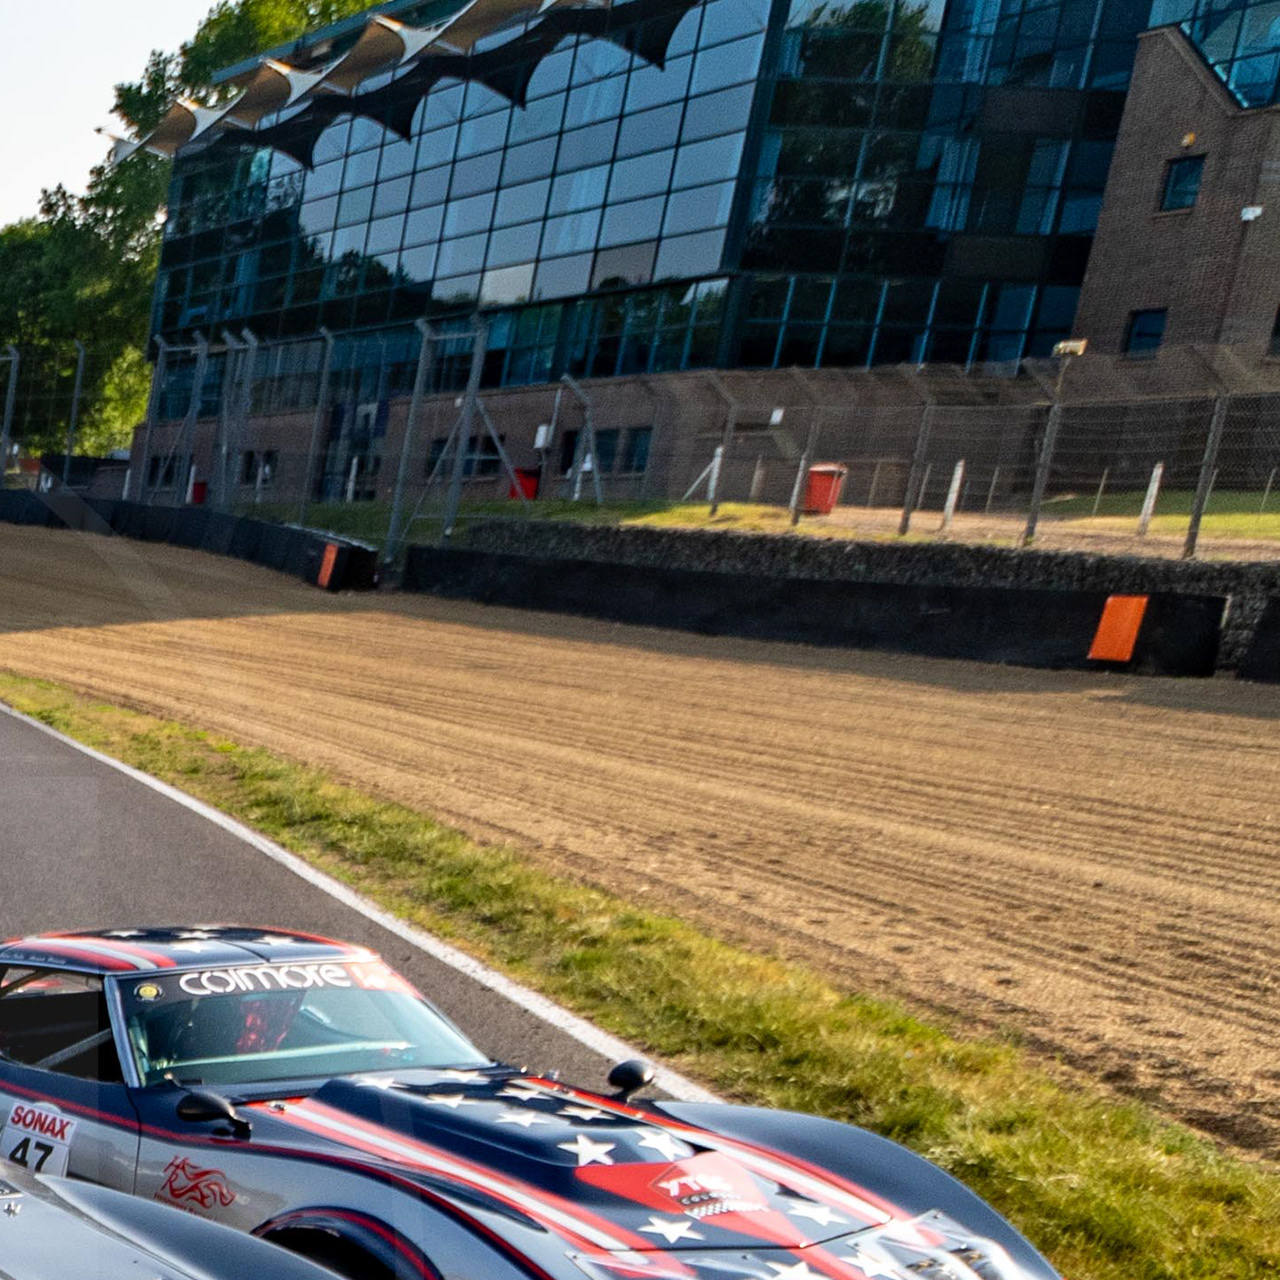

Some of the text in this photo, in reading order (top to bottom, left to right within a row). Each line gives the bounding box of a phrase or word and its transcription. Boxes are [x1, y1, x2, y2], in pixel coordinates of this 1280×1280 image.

[178, 963, 352, 996] colmore
[10, 1104, 71, 1141] SONAX
[8, 1136, 54, 1172] 47
